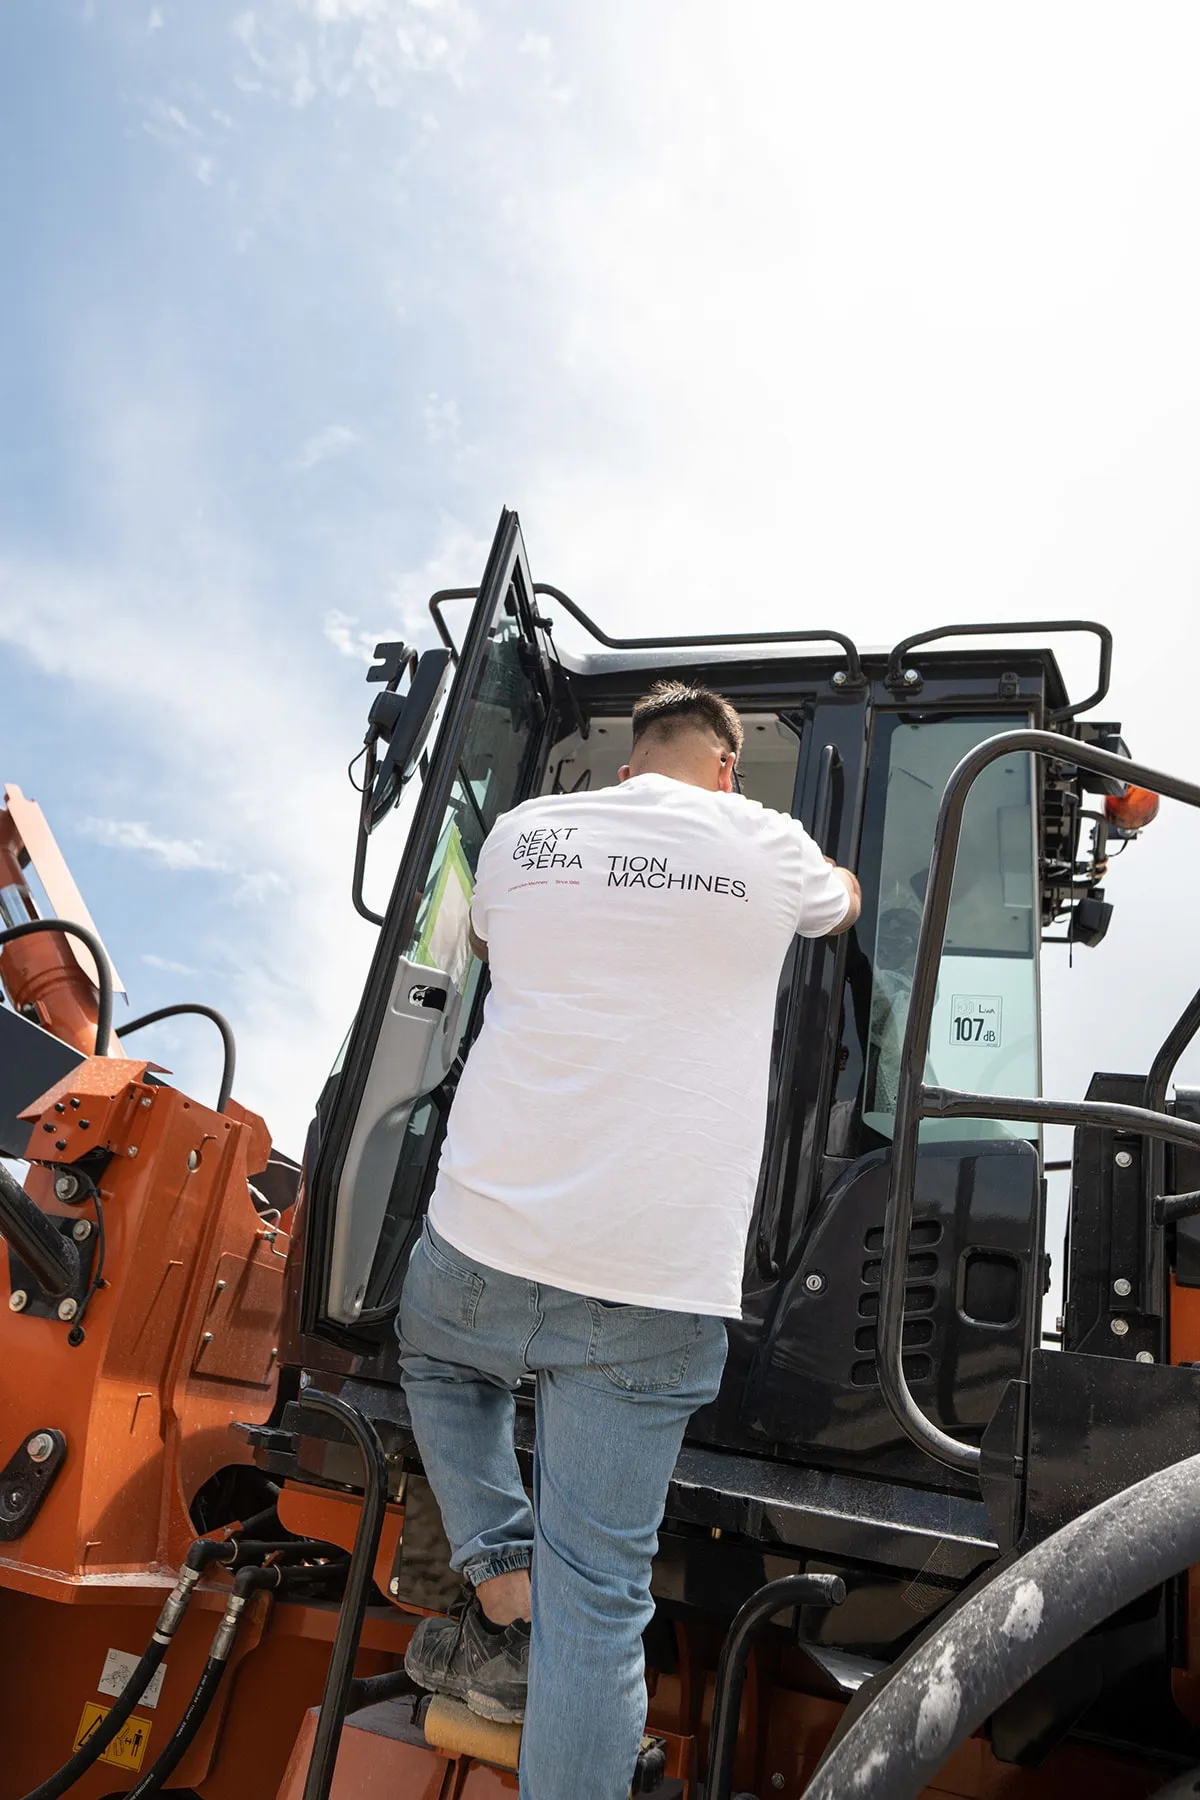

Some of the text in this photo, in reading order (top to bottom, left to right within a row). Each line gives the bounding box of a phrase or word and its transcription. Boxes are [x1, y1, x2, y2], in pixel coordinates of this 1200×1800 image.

[517, 828, 578, 846] NEXT
[513, 841, 557, 860] GEN
[536, 853, 667, 872] ERA TION
[954, 1017, 996, 1042] 107 dB
